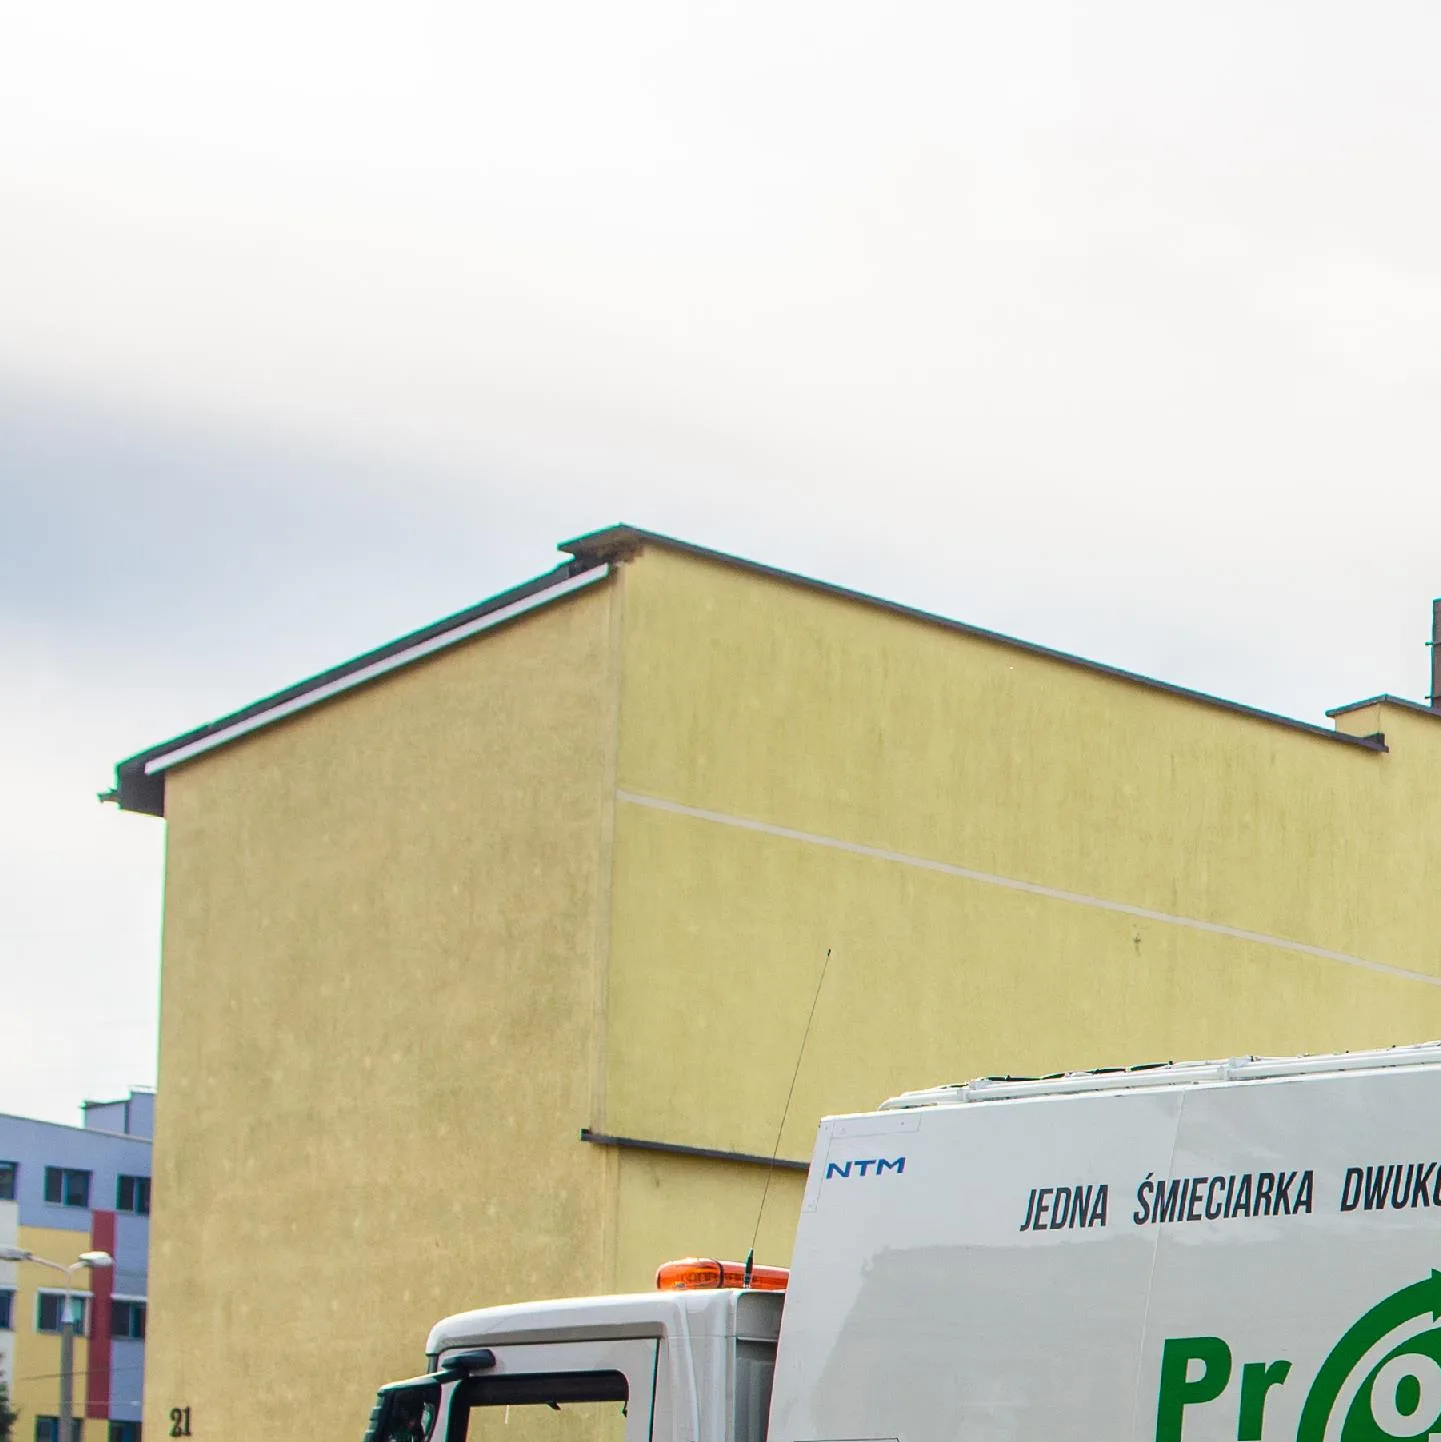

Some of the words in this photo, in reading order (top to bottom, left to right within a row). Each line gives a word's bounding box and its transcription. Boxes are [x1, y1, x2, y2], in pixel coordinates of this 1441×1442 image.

[826, 1156, 906, 1180] NTM
[1019, 1184, 1109, 1232] JEDNA
[1133, 1170, 1314, 1226] ŚMIECIARKA
[170, 1407, 192, 1438] 21
